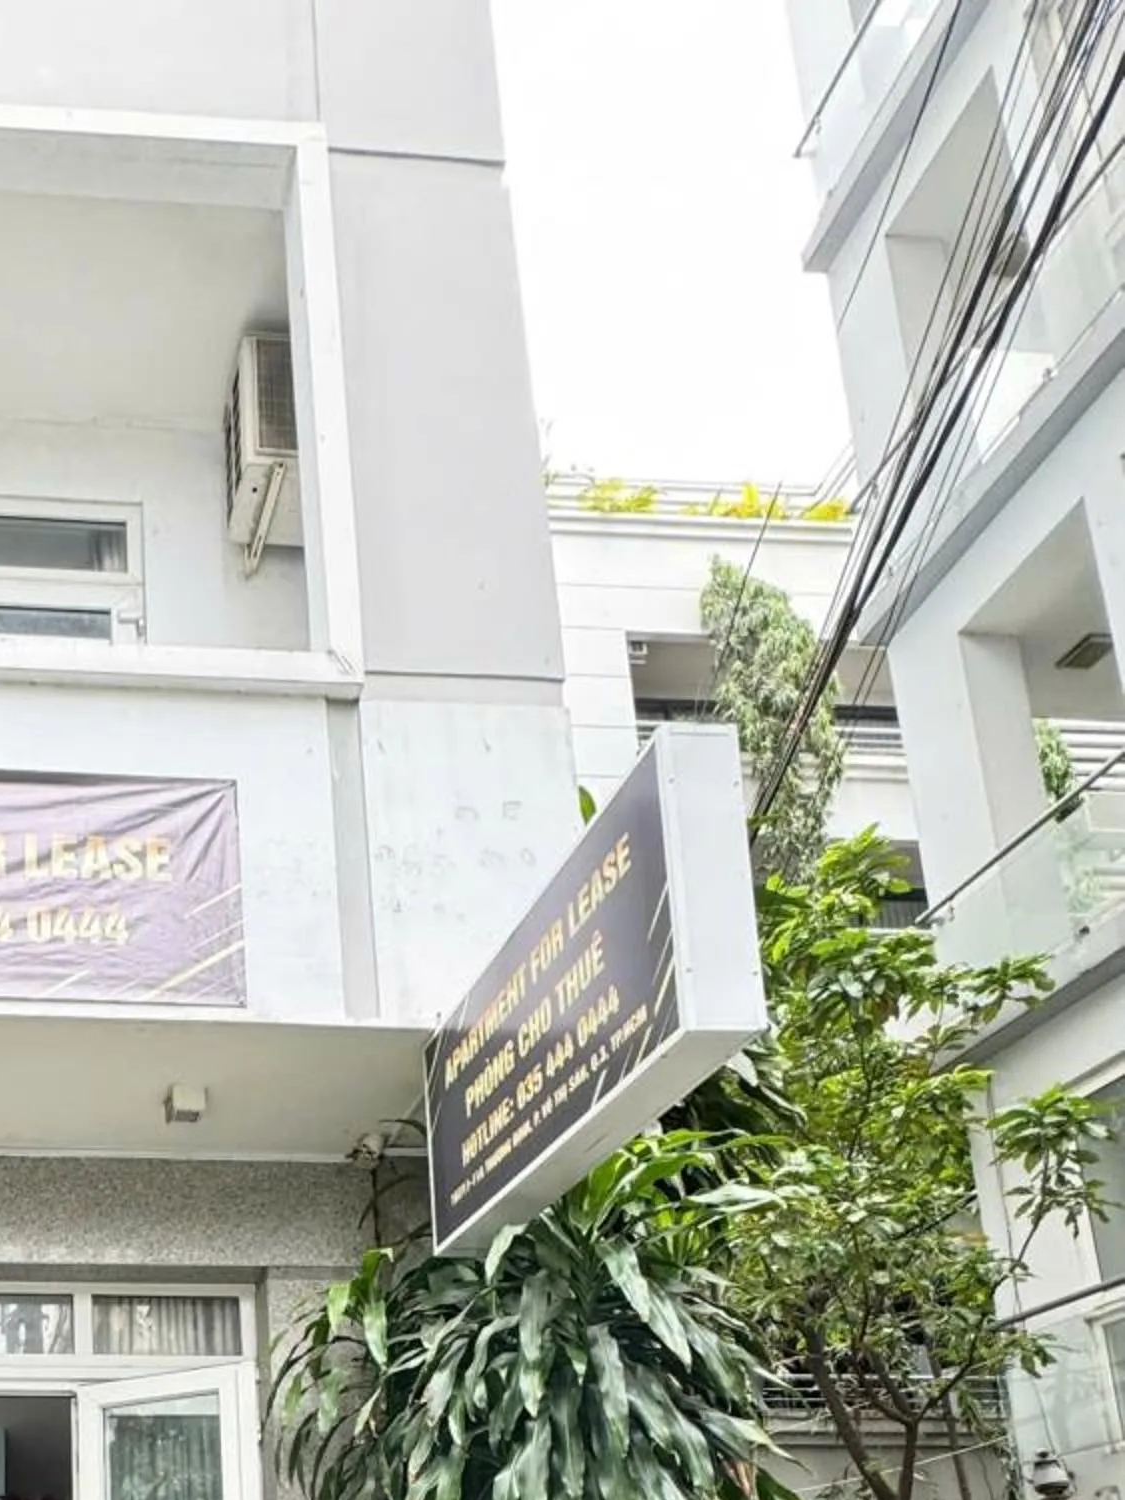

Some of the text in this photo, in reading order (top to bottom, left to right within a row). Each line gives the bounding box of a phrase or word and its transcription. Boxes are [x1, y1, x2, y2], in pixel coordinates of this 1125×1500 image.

[24, 831, 173, 882] LEASE
[27, 904, 129, 946] 0444
[443, 964, 526, 1090] APARTMENT
[530, 922, 564, 985] FOR
[567, 830, 633, 935] LEASE
[464, 1038, 516, 1119] PHÒNG
[517, 996, 553, 1059] CHO
[554, 928, 605, 1017] THUÊ
[461, 1095, 515, 1169] HOTLINE:
[515, 1062, 544, 1111] 035
[545, 1030, 575, 1078] 444
[576, 983, 620, 1049] 0444
